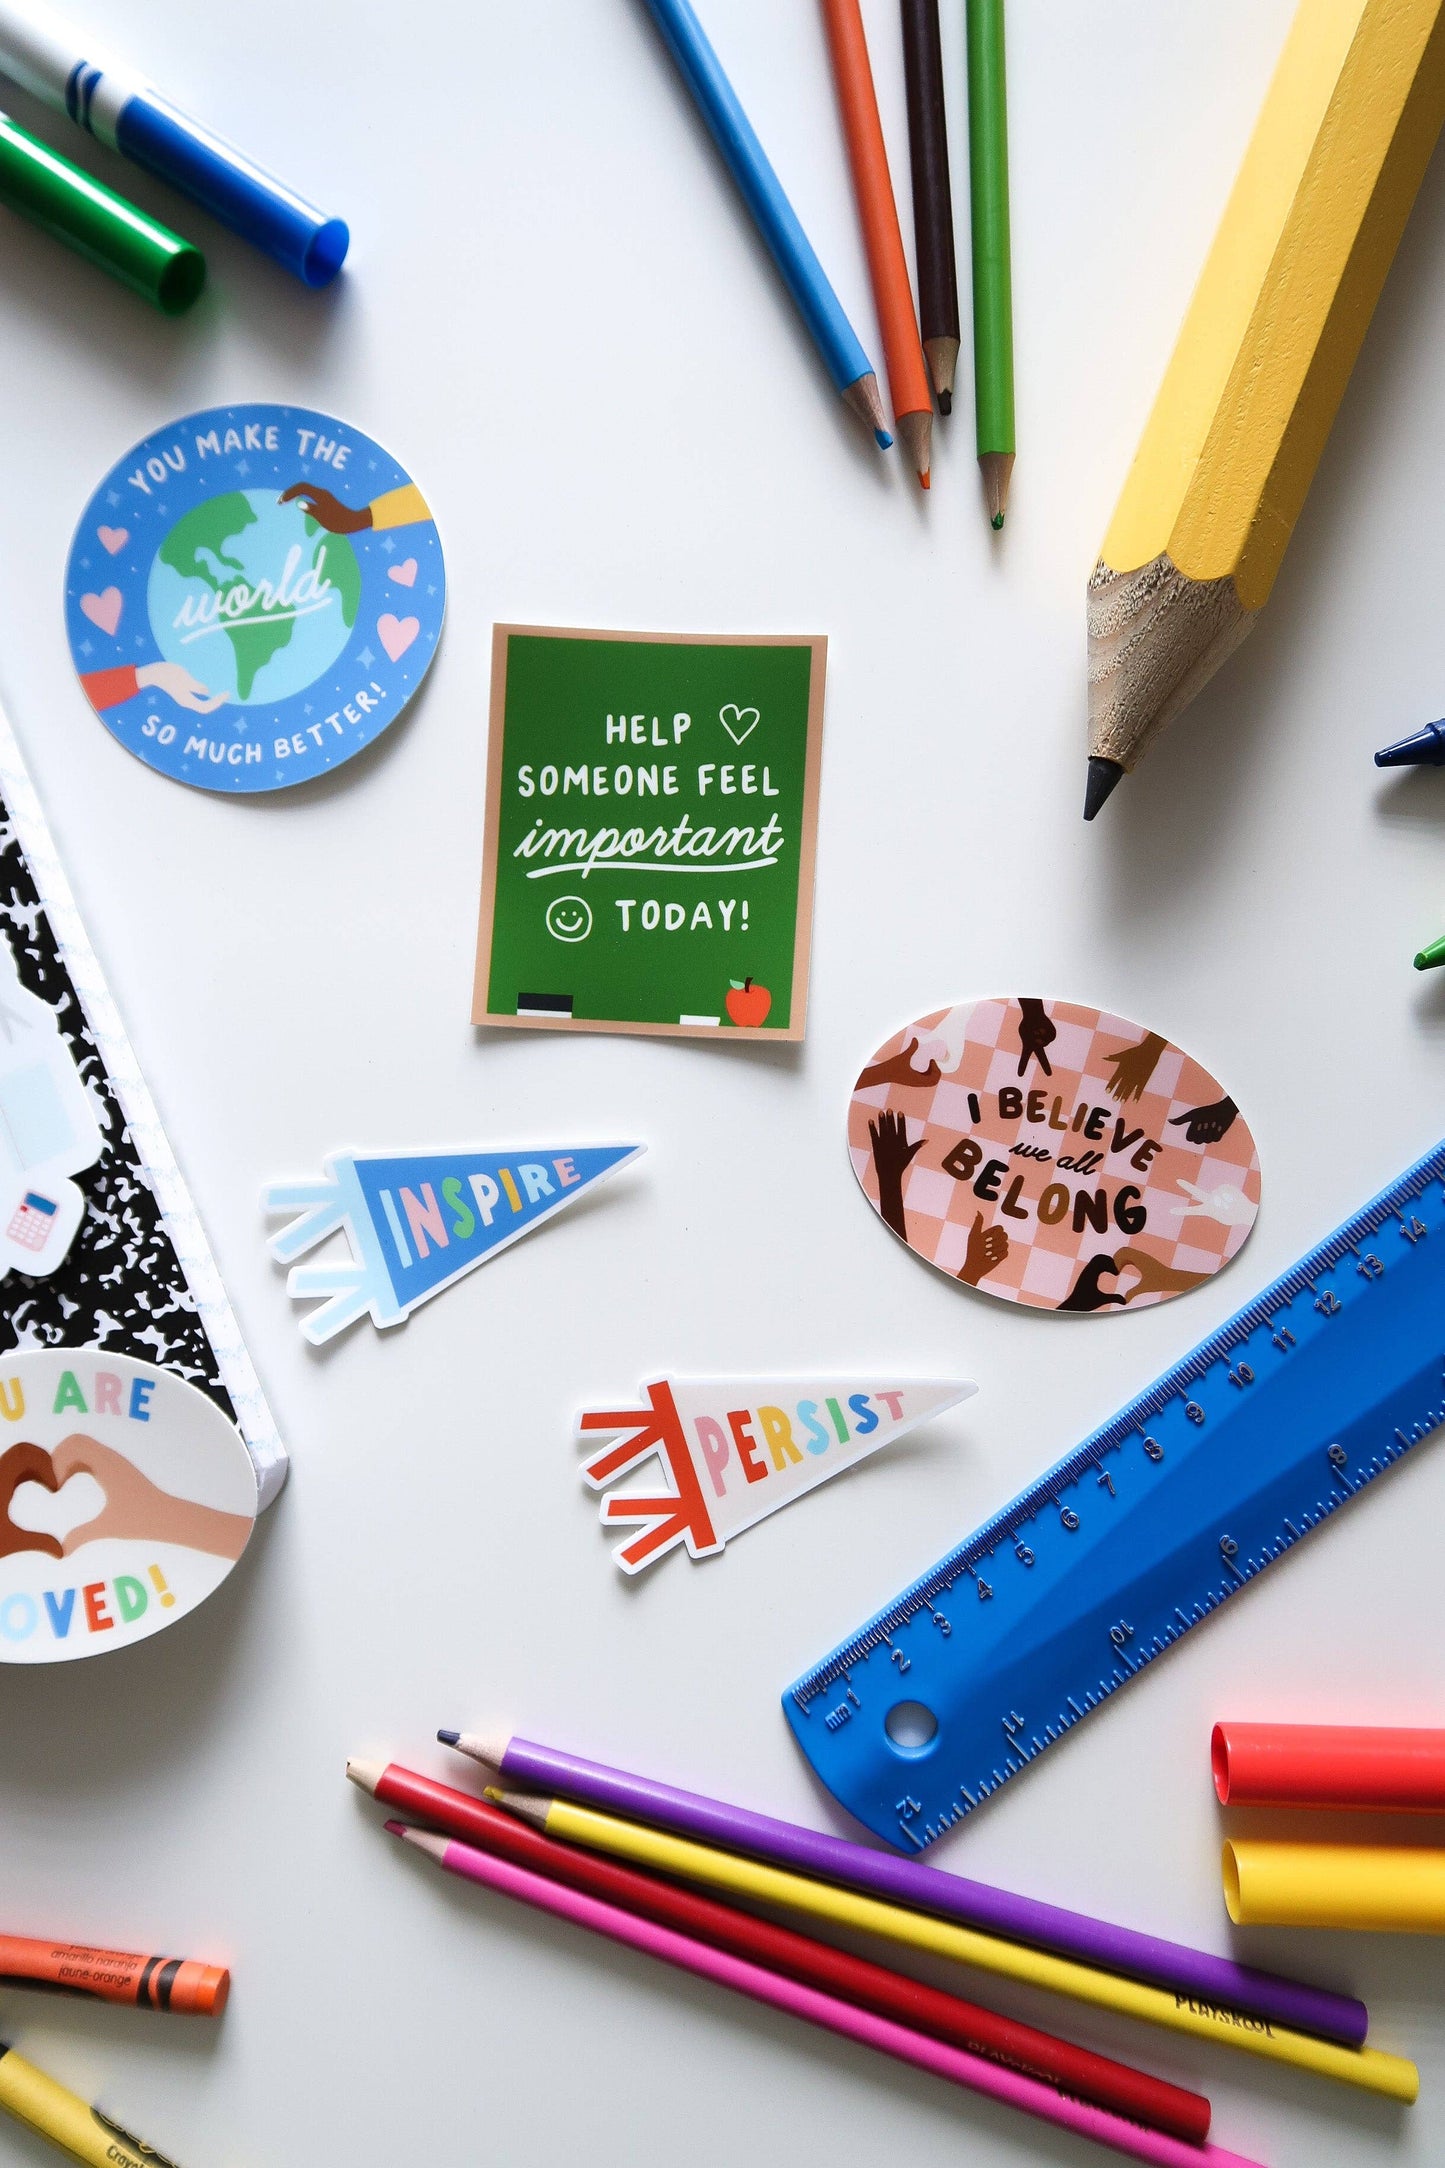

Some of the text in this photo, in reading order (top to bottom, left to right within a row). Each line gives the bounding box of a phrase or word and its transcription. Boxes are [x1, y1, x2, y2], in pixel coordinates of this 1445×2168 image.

[128, 424, 352, 495] YOU MAKE THE
[172, 544, 333, 629] world
[141, 680, 387, 765] SO MUCH BETTER!
[606, 713, 691, 746] HELP
[518, 763, 780, 797] SOMEONE FEEL
[514, 813, 785, 879] important
[615, 899, 750, 931] TODAY!
[967, 1086, 1164, 1172] I BELIEVE
[1008, 1141, 1105, 1176] we all
[941, 1138, 1147, 1235] BELONG
[379, 1156, 581, 1270] INSPIRE
[52, 1370, 156, 1422] ARE
[694, 1390, 904, 1497] PERSIST
[847, 1215, 1427, 1706] 1 2 3 4 5 6 7 8 9 10 11 12 13 14
[1327, 1443, 1348, 1465] 8
[1110, 1619, 1134, 1644] 10
[824, 1702, 852, 1730] mm
[1002, 1710, 1025, 1734] 11
[895, 1795, 922, 1819] 12
[51, 1950, 94, 1964] amarillo
[96, 1957, 137, 1971] naranja
[58, 1964, 131, 1987] jaune-orange
[1175, 1992, 1276, 2039] PLAYSKOOL
